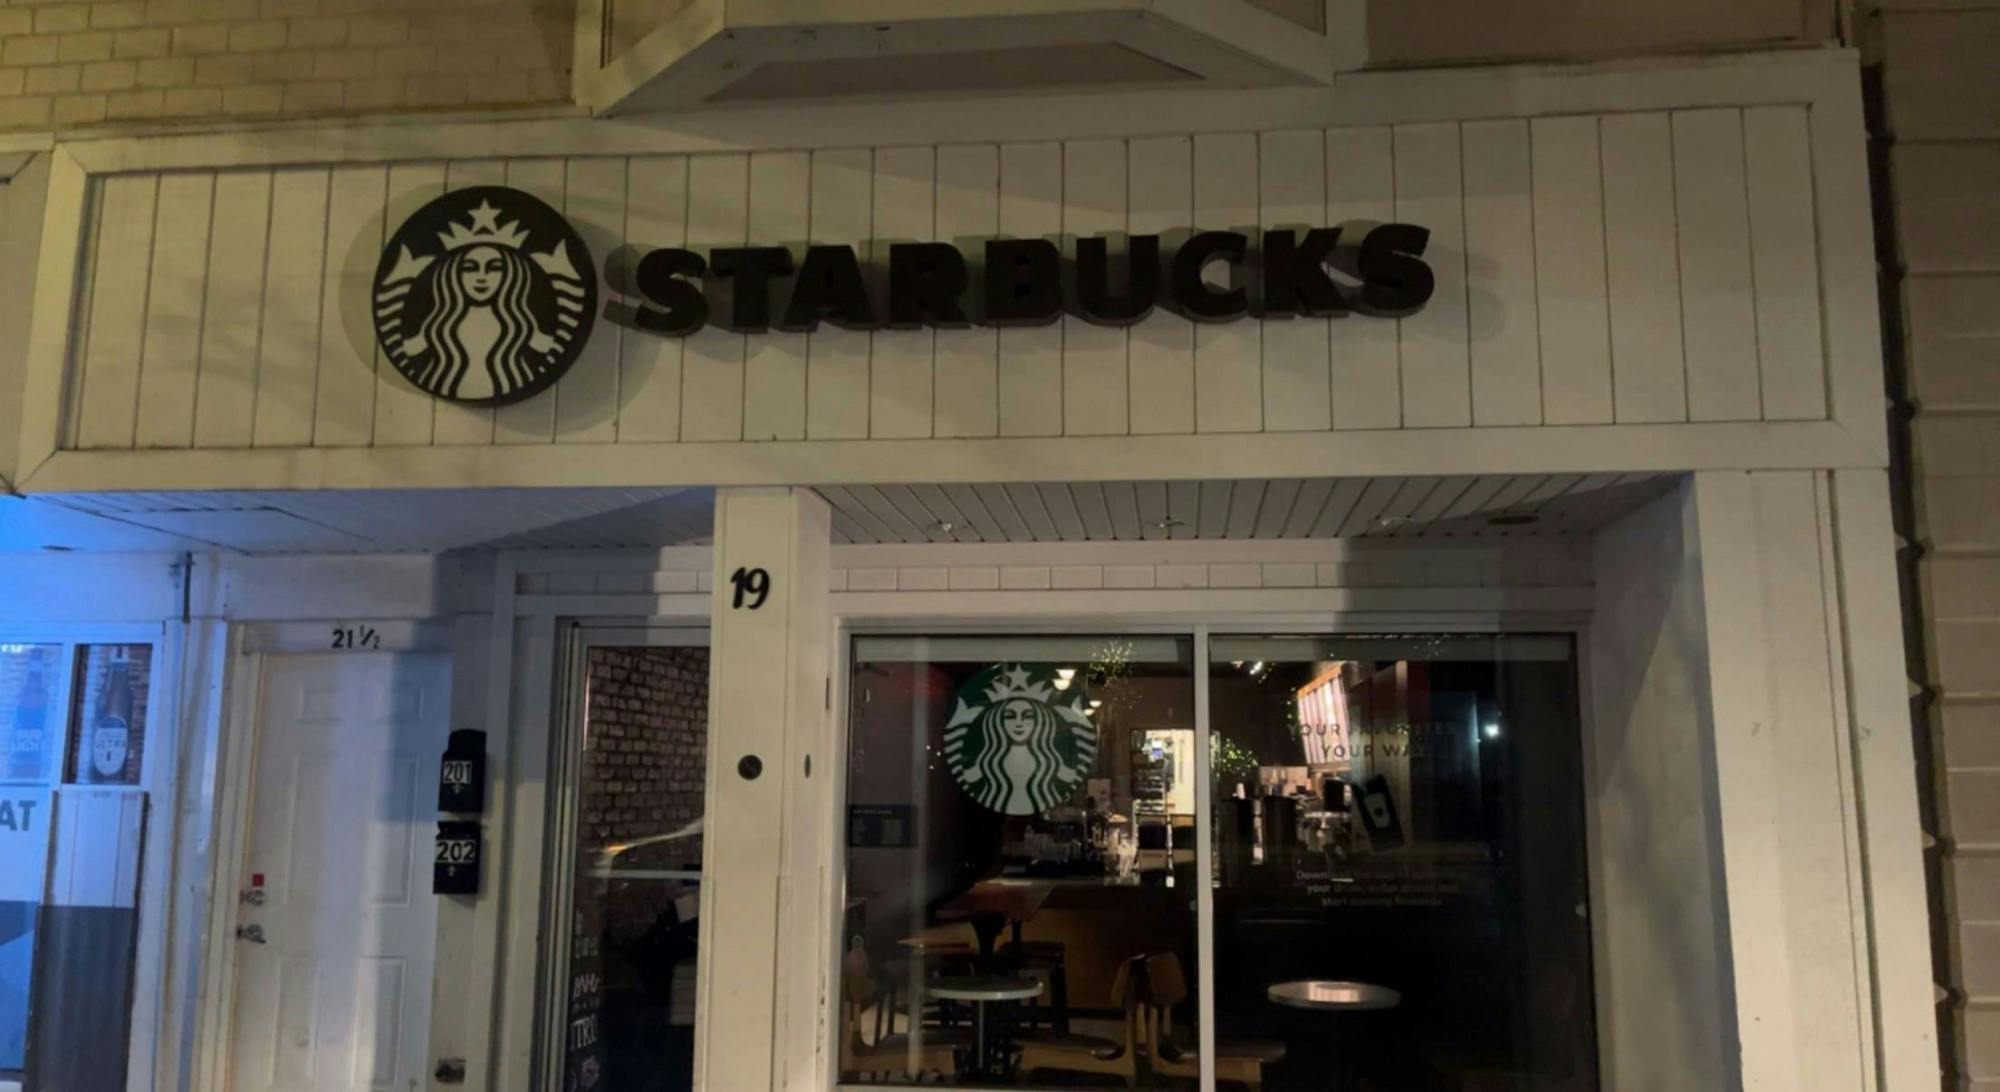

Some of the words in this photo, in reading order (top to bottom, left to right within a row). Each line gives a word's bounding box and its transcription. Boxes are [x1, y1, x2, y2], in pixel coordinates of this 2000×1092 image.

[634, 223, 1436, 335] STARBUCKS
[730, 567, 770, 610] 19
[332, 629, 353, 648] 21
[1286, 723, 1341, 736] YOUR
[1321, 745, 1373, 758] YOUR
[443, 761, 472, 783] 201
[437, 841, 475, 862] 202
